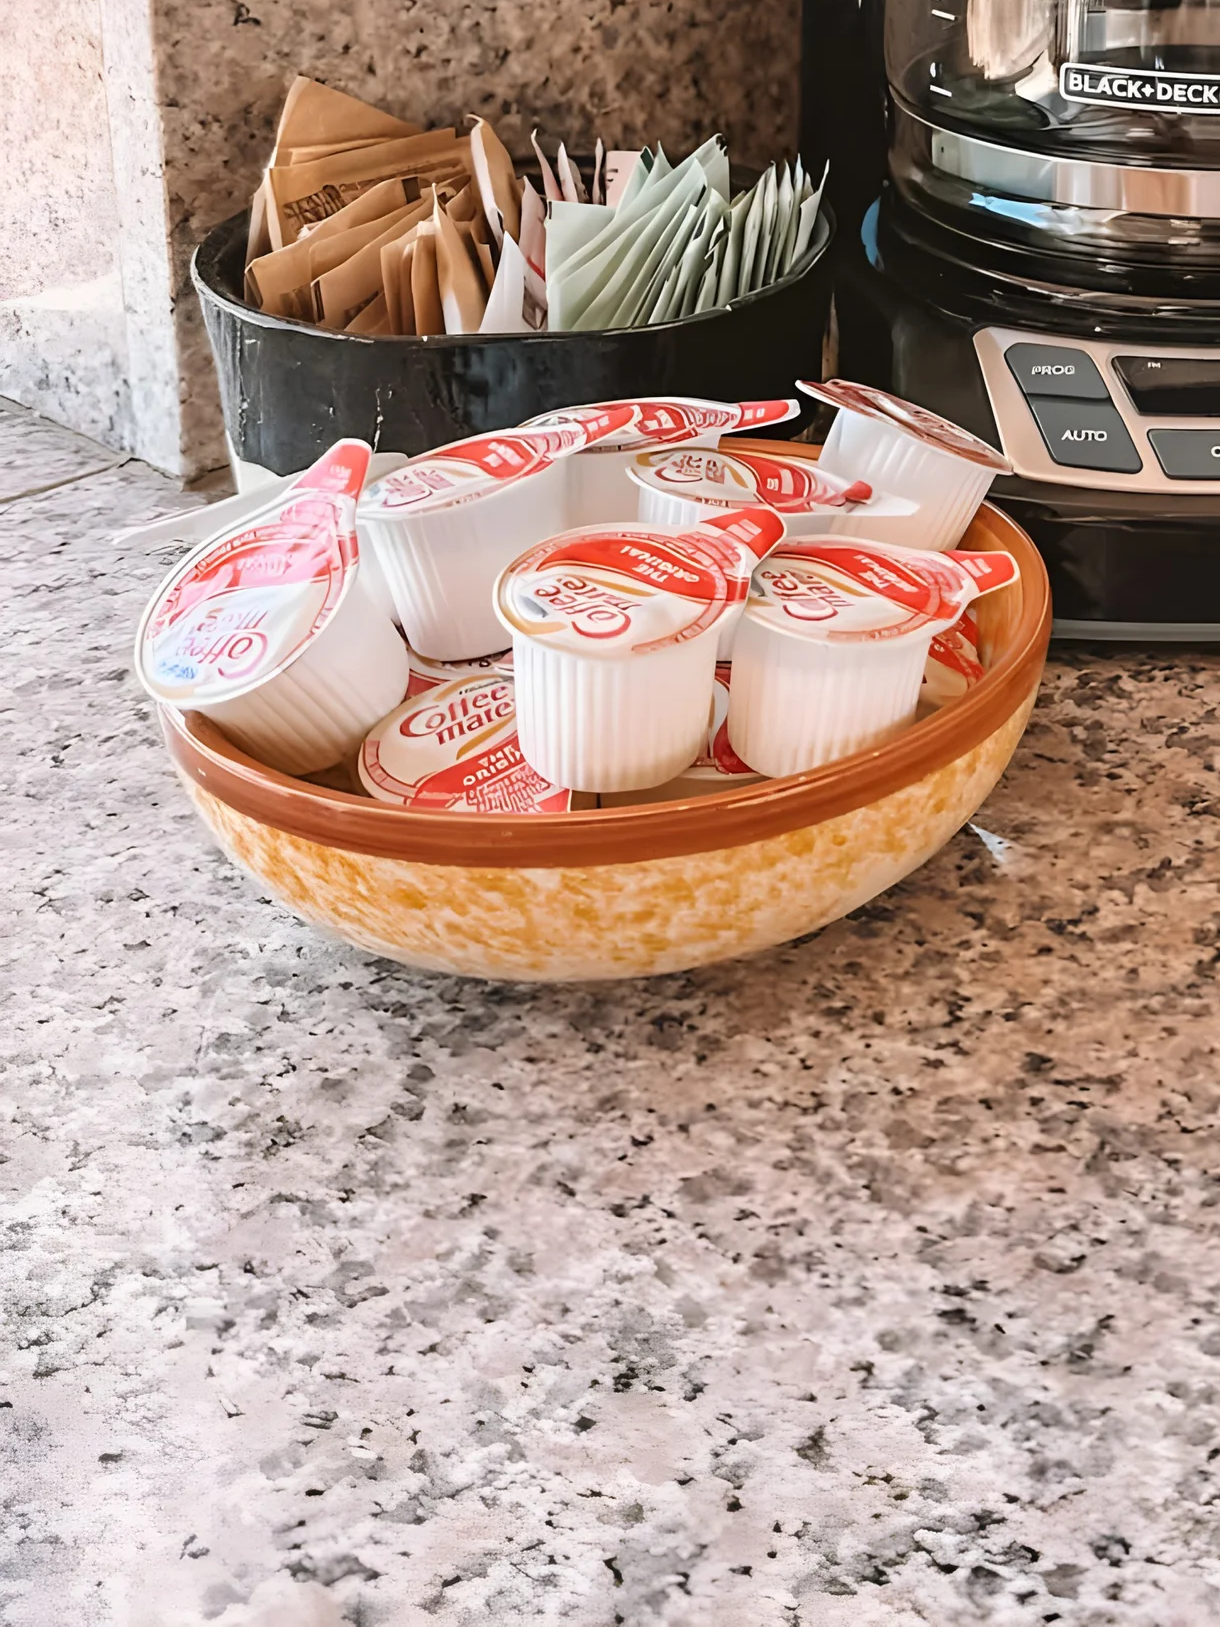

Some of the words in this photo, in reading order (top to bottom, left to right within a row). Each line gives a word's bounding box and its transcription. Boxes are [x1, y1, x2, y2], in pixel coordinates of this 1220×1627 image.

[1061, 429, 1108, 442] AUTO
[534, 584, 631, 640] Coffee
[400, 685, 509, 738] Coffee
